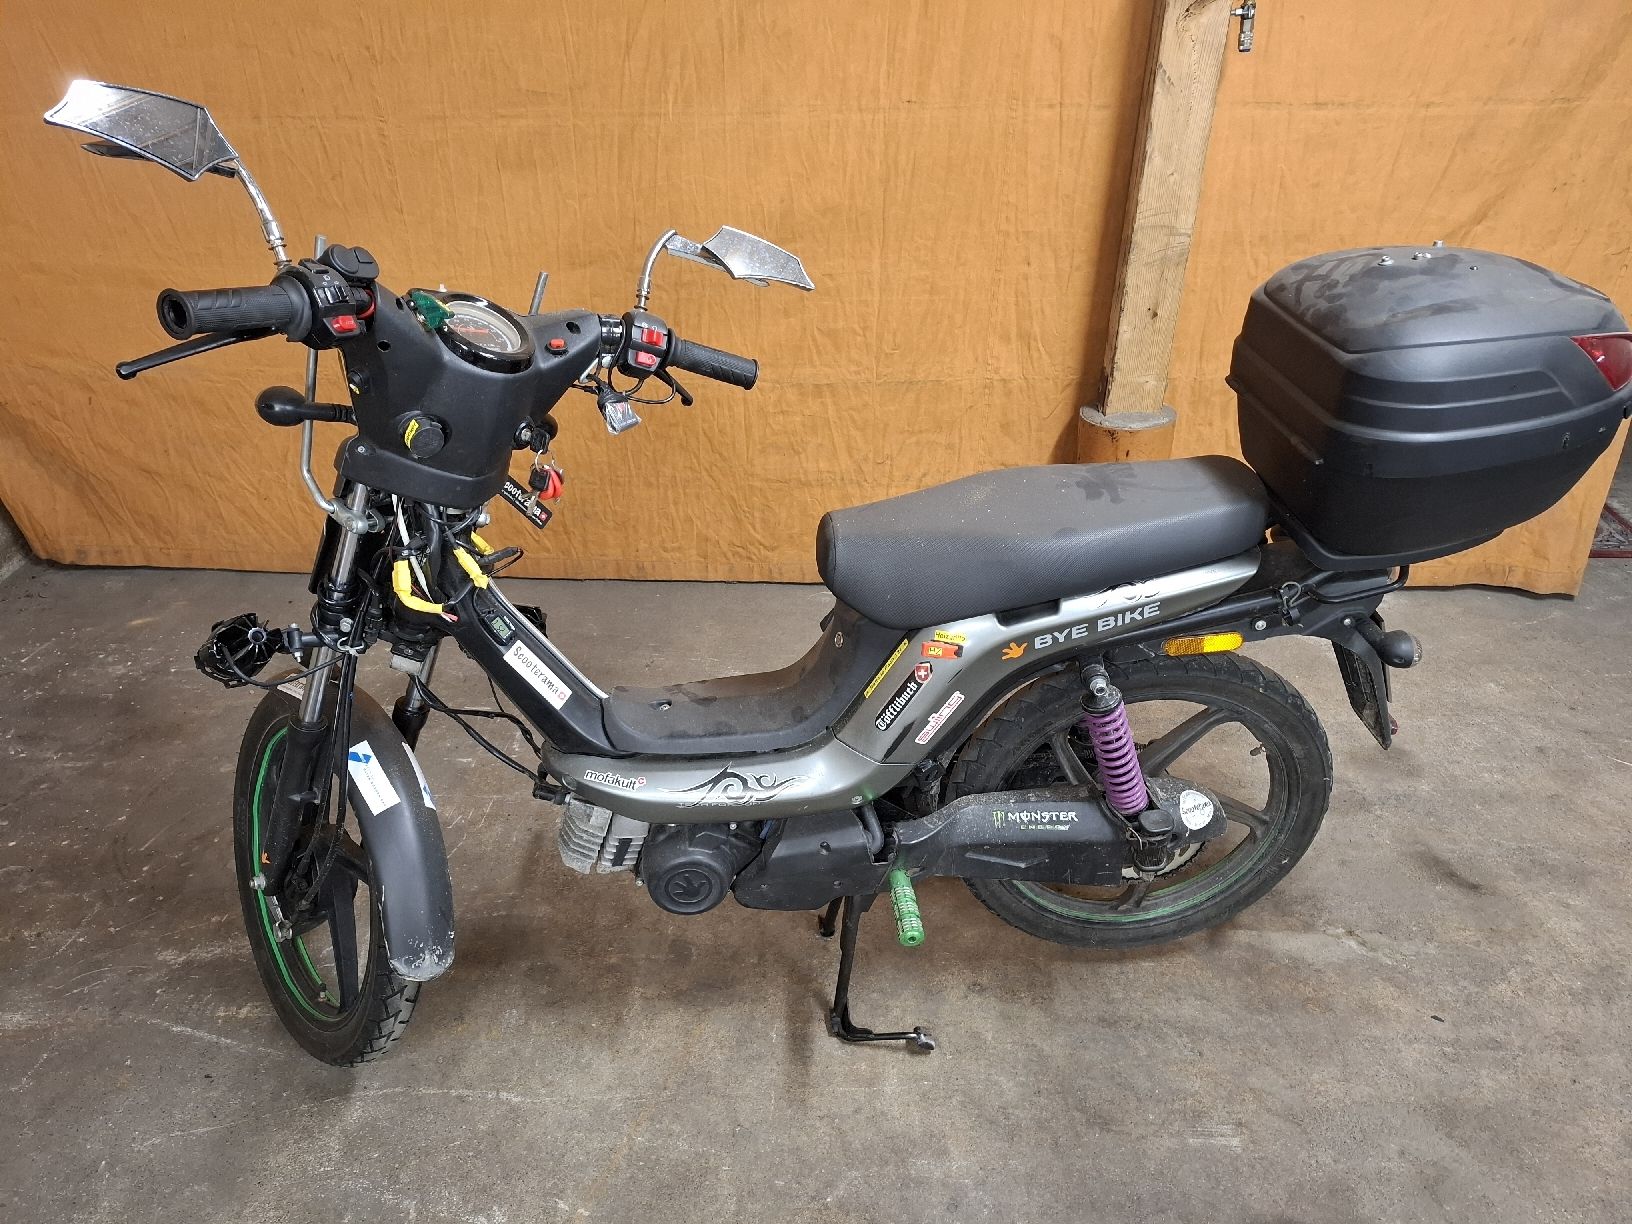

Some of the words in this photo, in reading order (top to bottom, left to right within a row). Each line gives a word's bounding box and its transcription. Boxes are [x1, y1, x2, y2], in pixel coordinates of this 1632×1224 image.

[1034, 623, 1089, 650] BYE
[1097, 601, 1161, 632] BIKE
[513, 646, 559, 695] Scooterama
[1007, 810, 1079, 823] MONSTER
